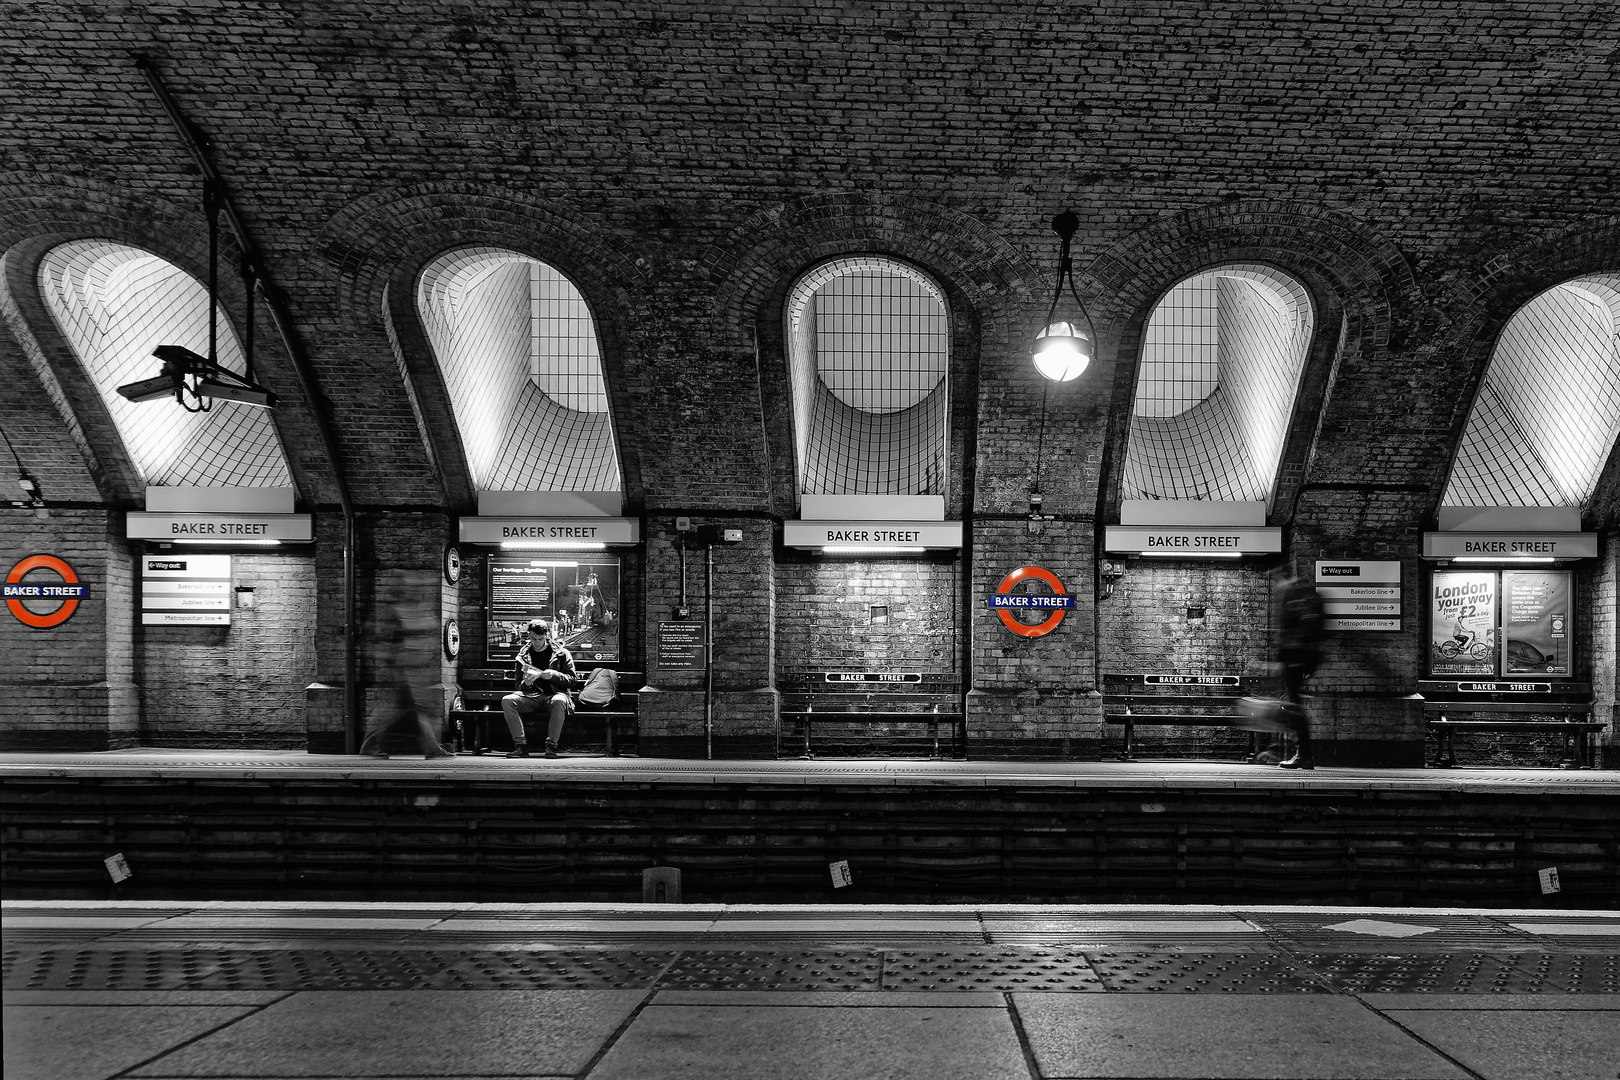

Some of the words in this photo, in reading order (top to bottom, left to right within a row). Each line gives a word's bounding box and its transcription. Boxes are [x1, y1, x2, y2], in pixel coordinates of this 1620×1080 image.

[171, 523, 215, 534] BAKER
[220, 523, 268, 535] STREET
[502, 527, 545, 538] BAKER
[550, 527, 597, 538] STREET
[827, 531, 869, 541] BAKER
[873, 531, 920, 542] STREET
[1148, 536, 1190, 547] BAKER
[1194, 536, 1240, 547] STREET
[1465, 541, 1507, 552] BAKER
[1511, 542, 1557, 552] STREET
[4, 586, 40, 596] BAKER
[42, 586, 83, 596] STREET
[1435, 581, 1488, 600] London
[995, 596, 1029, 606] BAKER
[1031, 597, 1069, 607] STREET
[1438, 597, 1466, 612] your
[1468, 593, 1493, 606] way
[1442, 607, 1459, 616] from
[1460, 604, 1476, 619] £2
